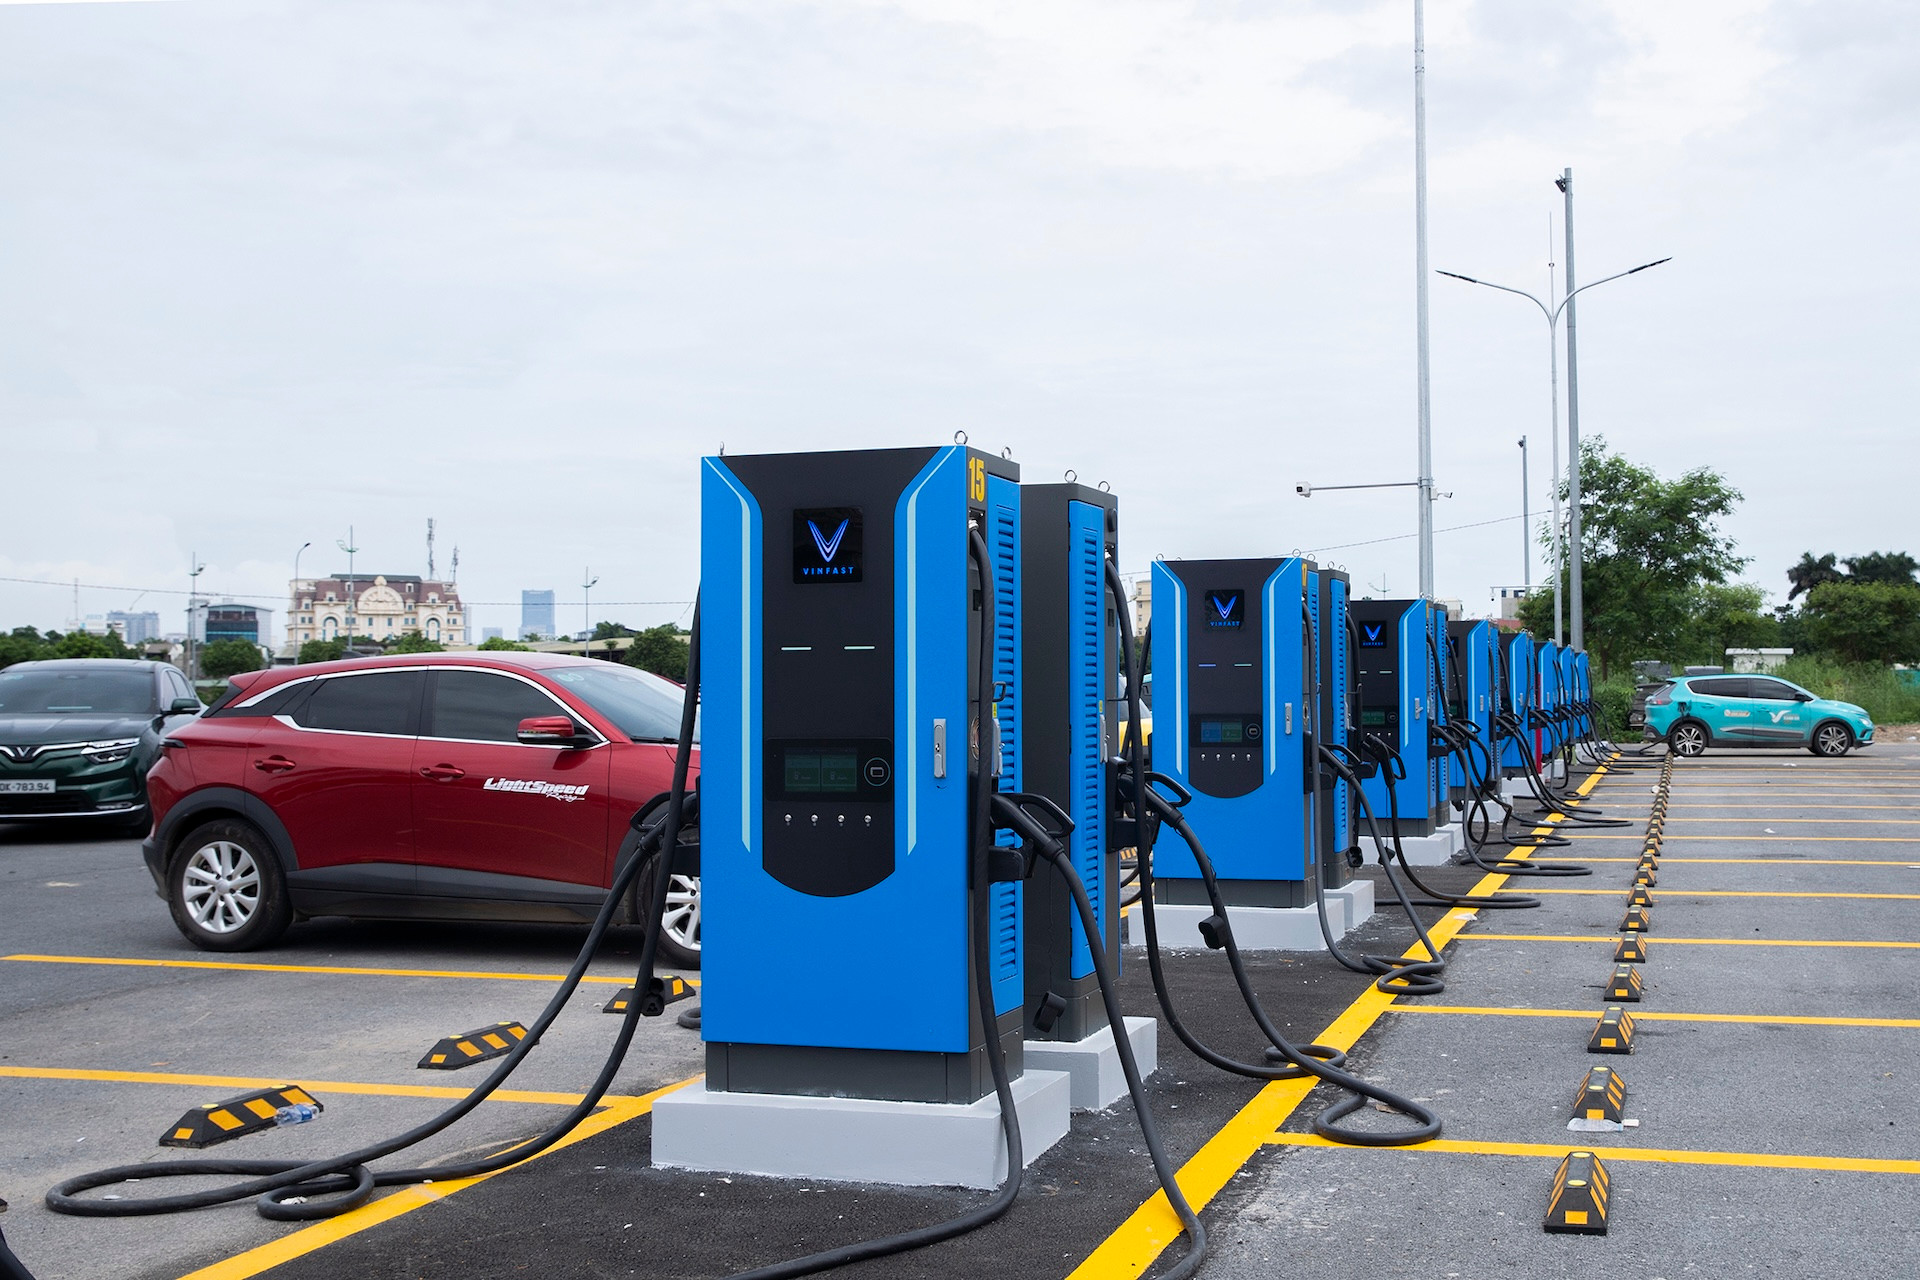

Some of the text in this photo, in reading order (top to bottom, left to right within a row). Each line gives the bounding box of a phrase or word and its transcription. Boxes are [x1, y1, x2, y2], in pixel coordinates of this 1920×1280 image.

[969, 456, 985, 502] 15
[802, 567, 854, 576] VINFAST
[483, 778, 589, 795] LightSpeed
